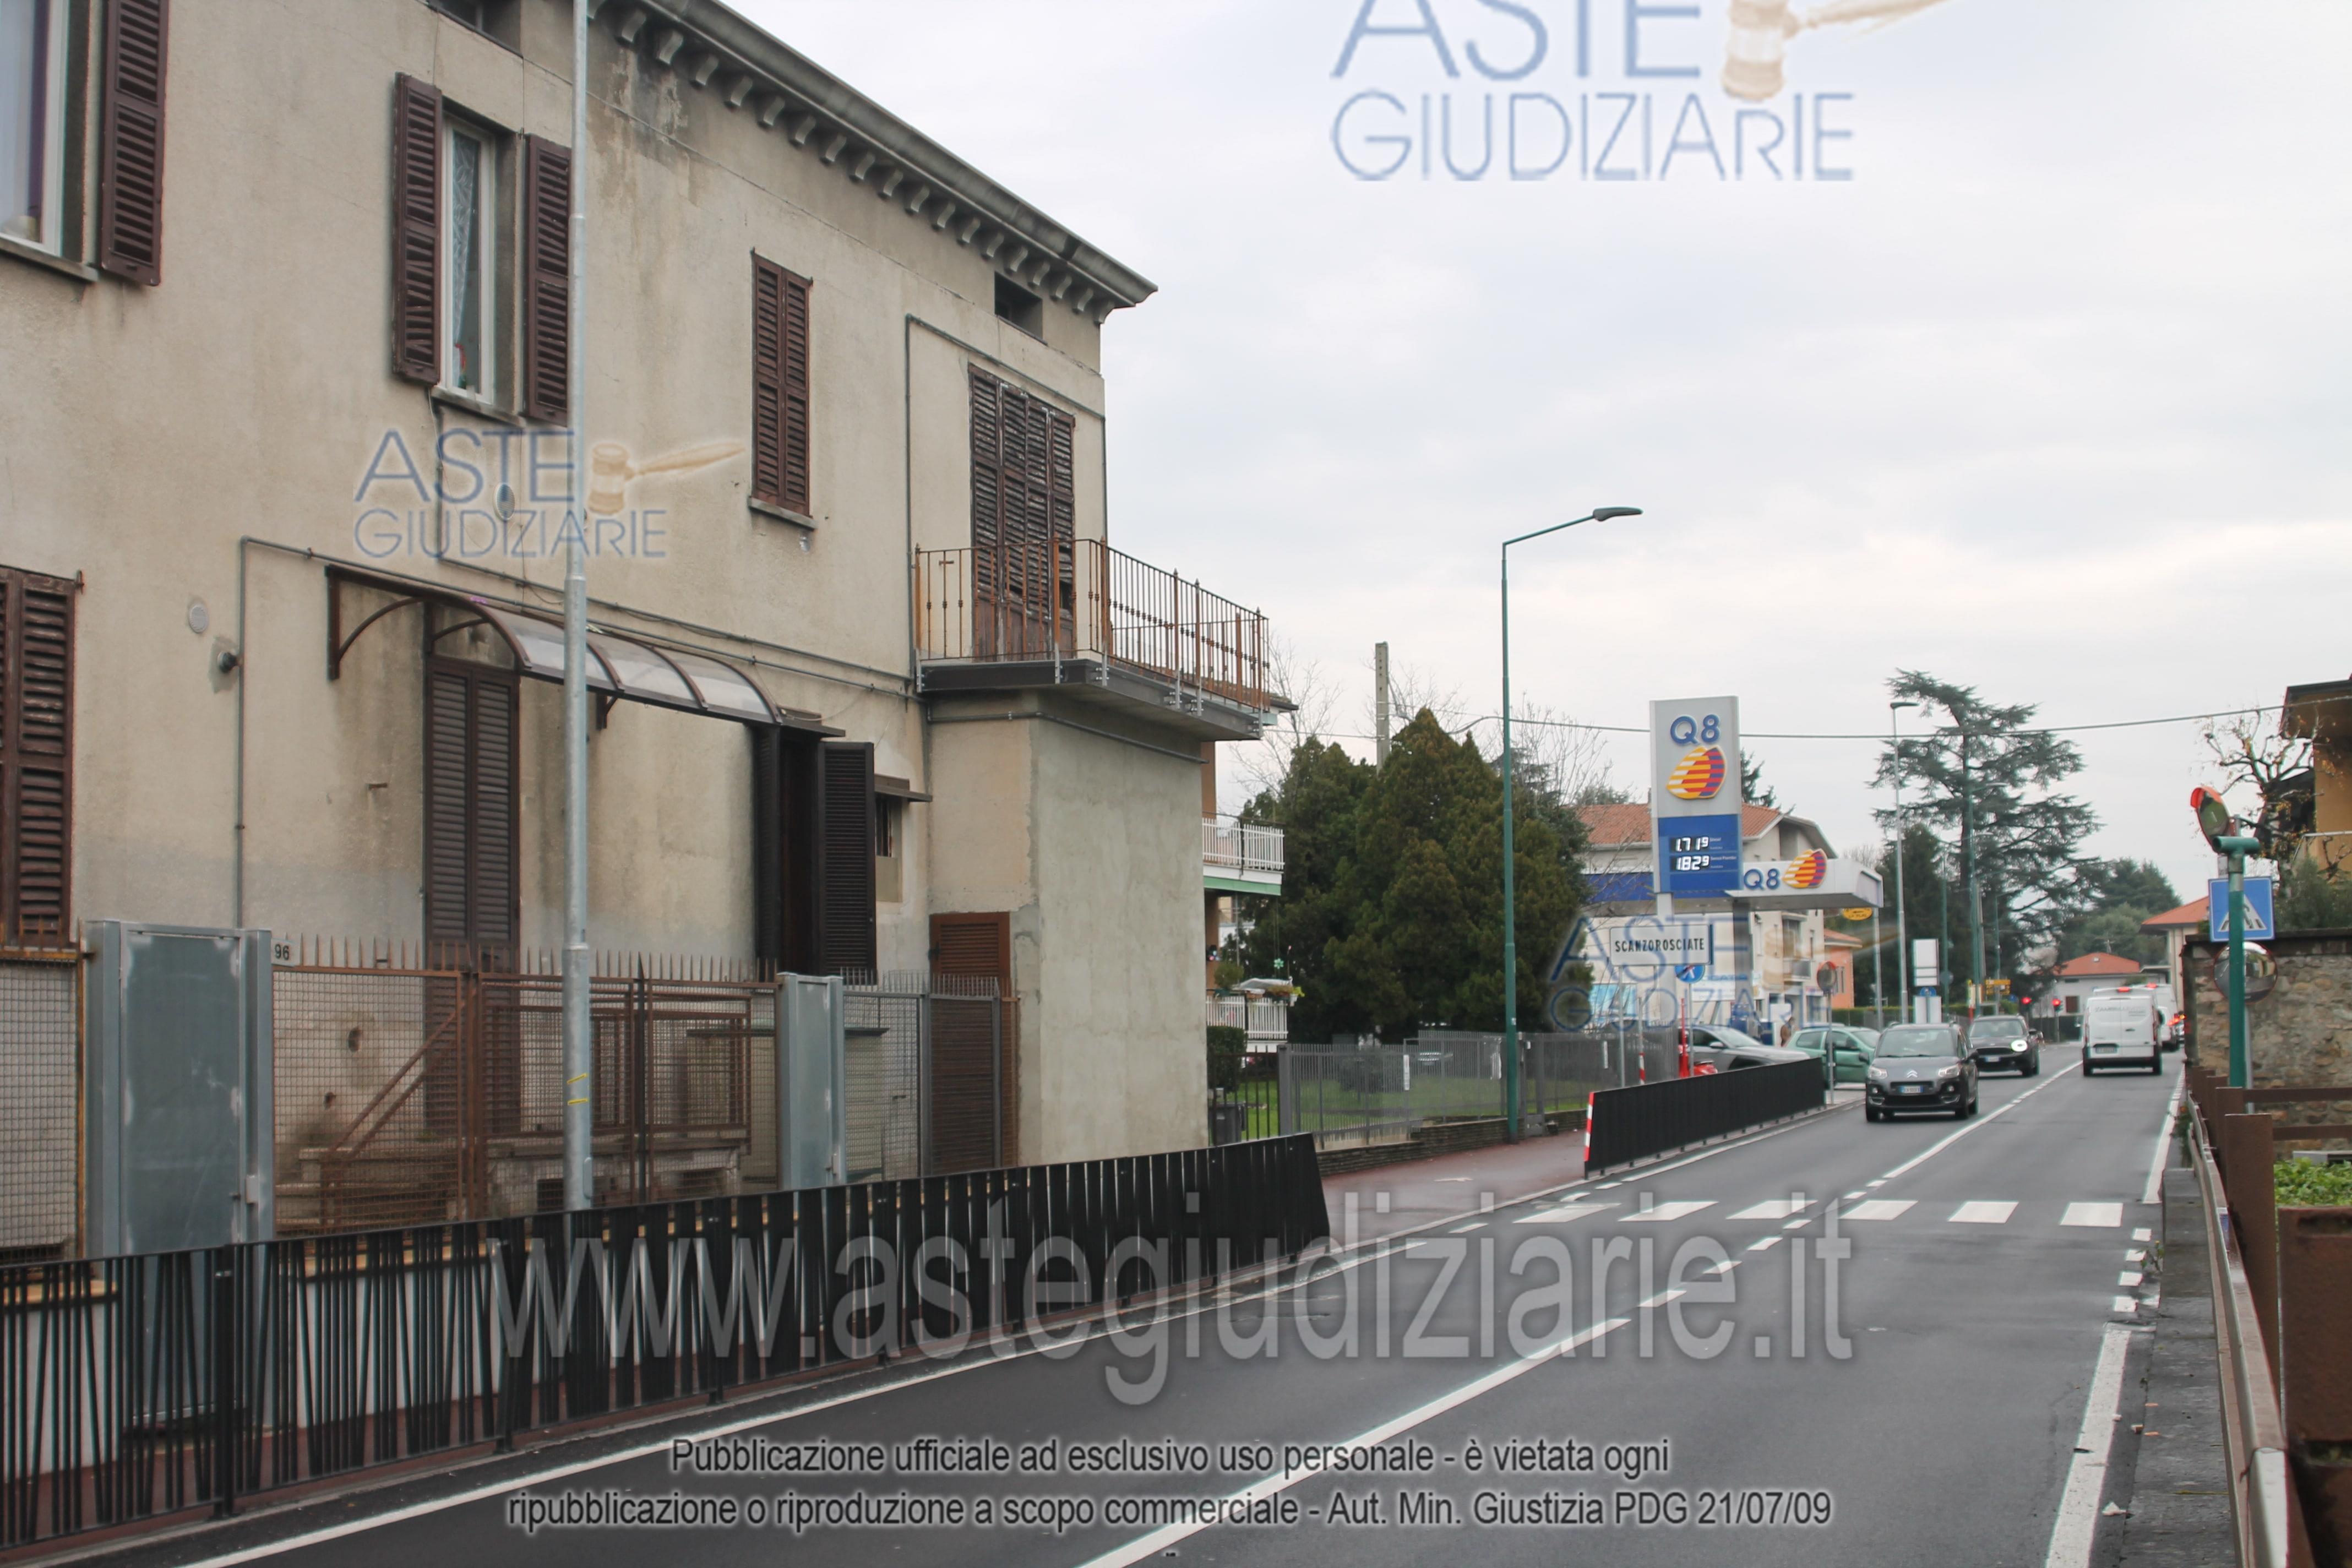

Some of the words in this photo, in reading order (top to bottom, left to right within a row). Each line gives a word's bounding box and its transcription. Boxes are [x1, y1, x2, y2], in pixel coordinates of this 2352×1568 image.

[1670, 714, 1720, 744] Q8
[1744, 868, 1781, 890] Q8
[275, 944, 290, 961] 96
[1615, 938, 1705, 952] SCANZOROSCIATE
